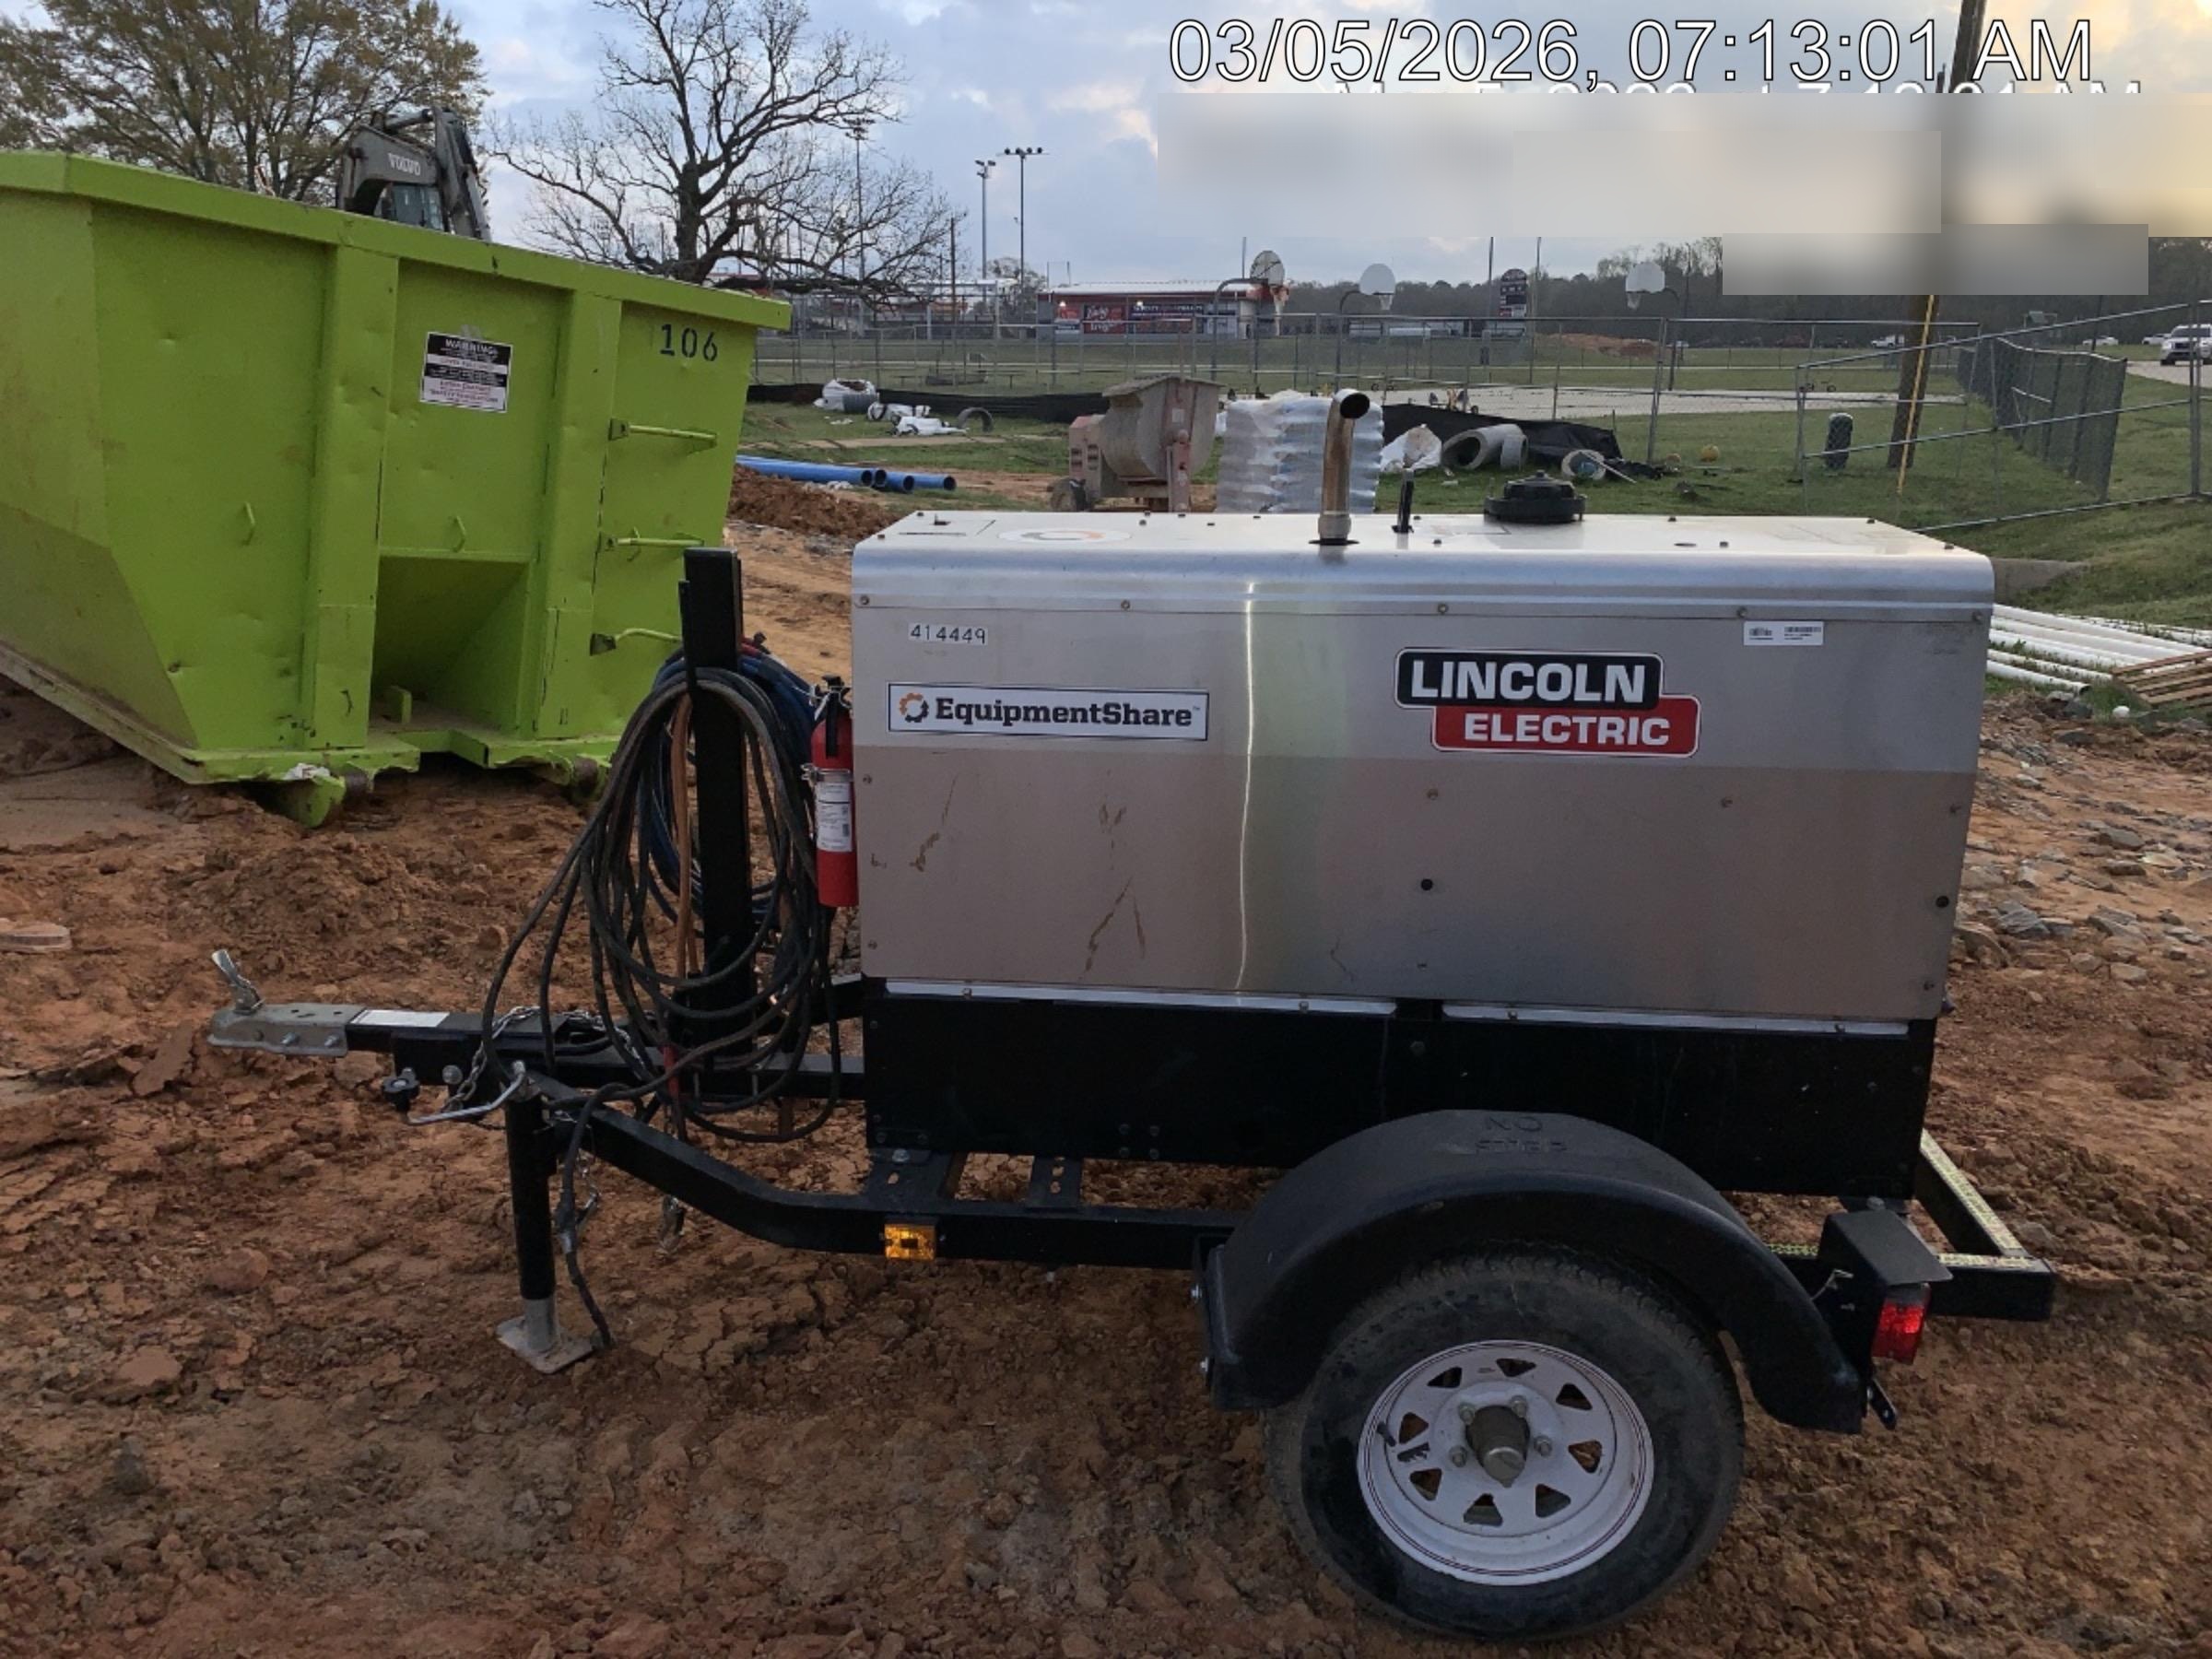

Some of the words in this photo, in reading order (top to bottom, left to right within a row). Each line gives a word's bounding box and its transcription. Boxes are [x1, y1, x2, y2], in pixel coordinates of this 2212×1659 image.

[660, 324, 718, 362] 106
[910, 624, 986, 645] 414449
[1411, 660, 1645, 703] LINCOLN
[1464, 712, 1671, 747] ELECTRIC
